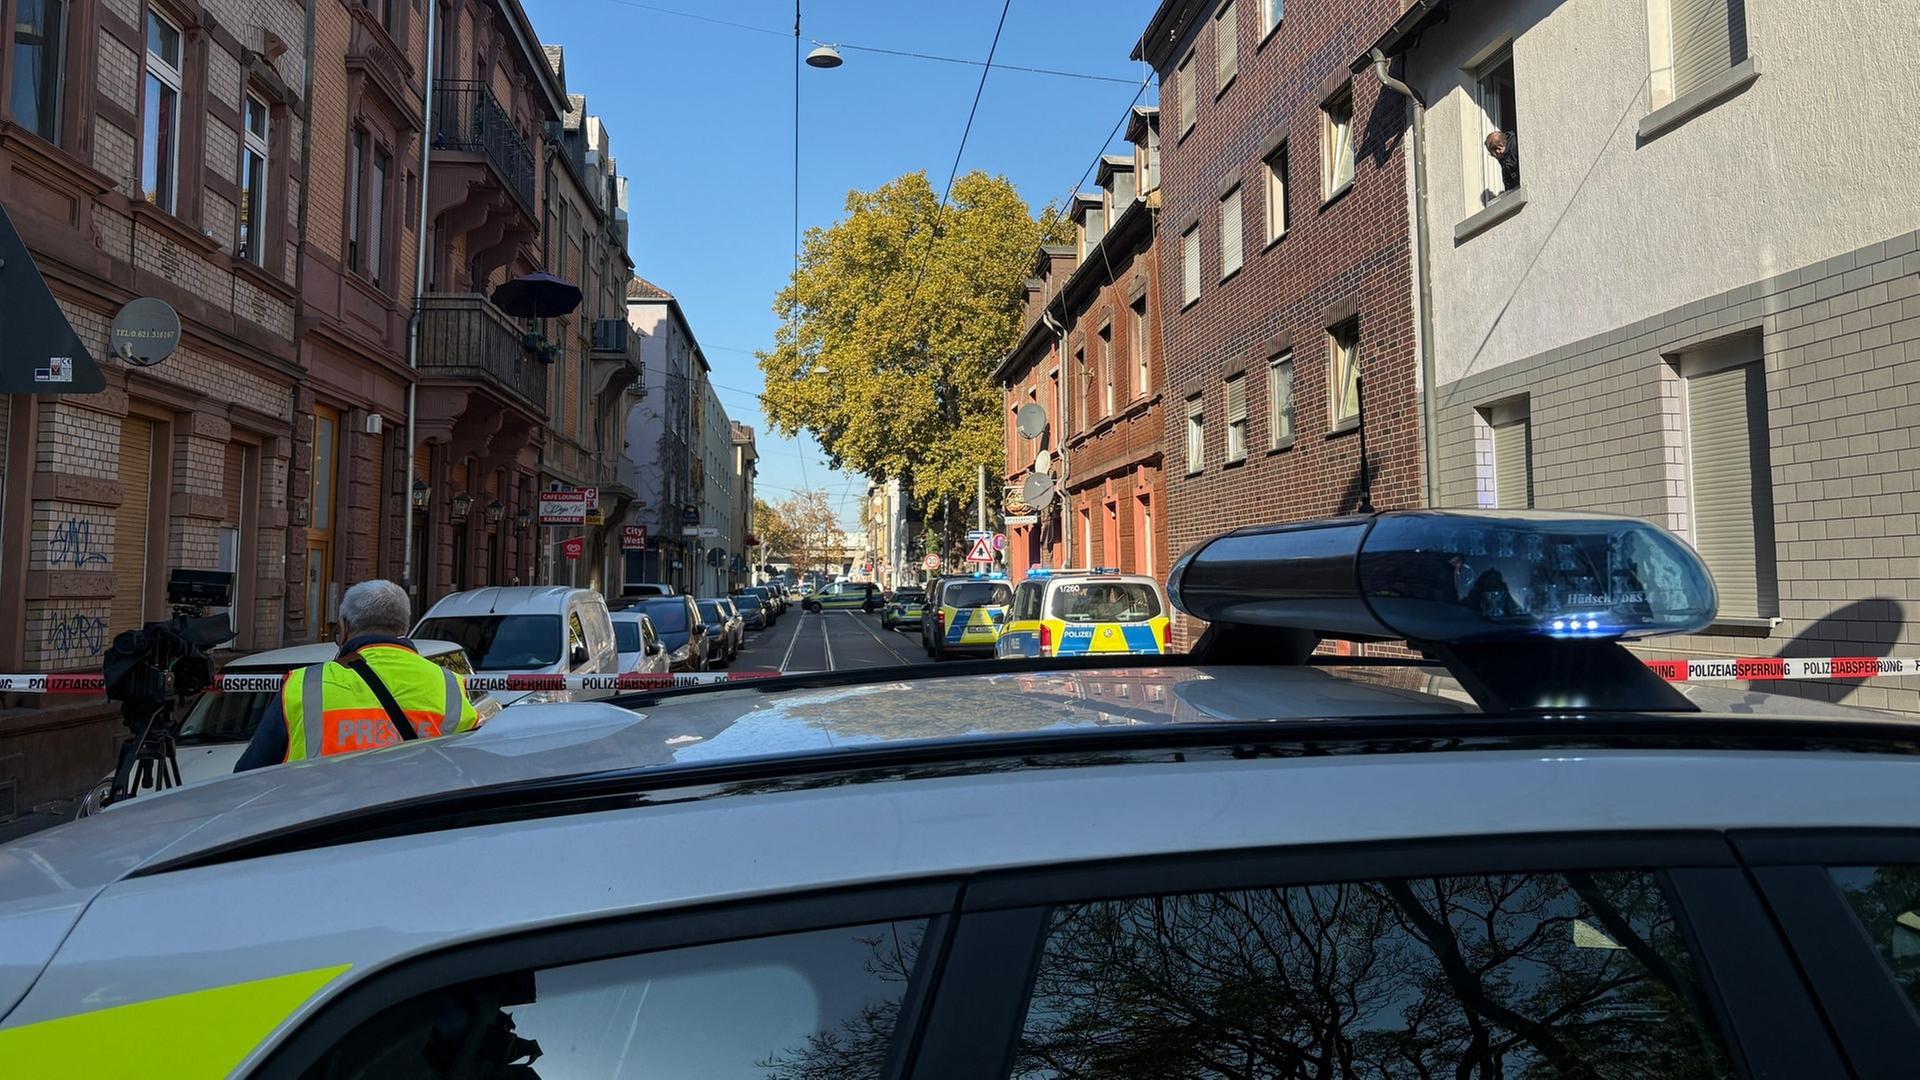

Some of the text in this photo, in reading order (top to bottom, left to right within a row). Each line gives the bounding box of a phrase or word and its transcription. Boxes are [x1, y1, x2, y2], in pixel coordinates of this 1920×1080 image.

[558, 493, 583, 501] LOUNGE
[625, 526, 644, 537] City
[623, 536, 645, 545] West
[1063, 630, 1093, 639] POLIZEI
[1688, 663, 1791, 678] POLIZEIABSPERRUNG
[1802, 660, 1903, 676] POLIZEIABSPERRUNG
[465, 675, 567, 691] LIZEIABSPERRUNG
